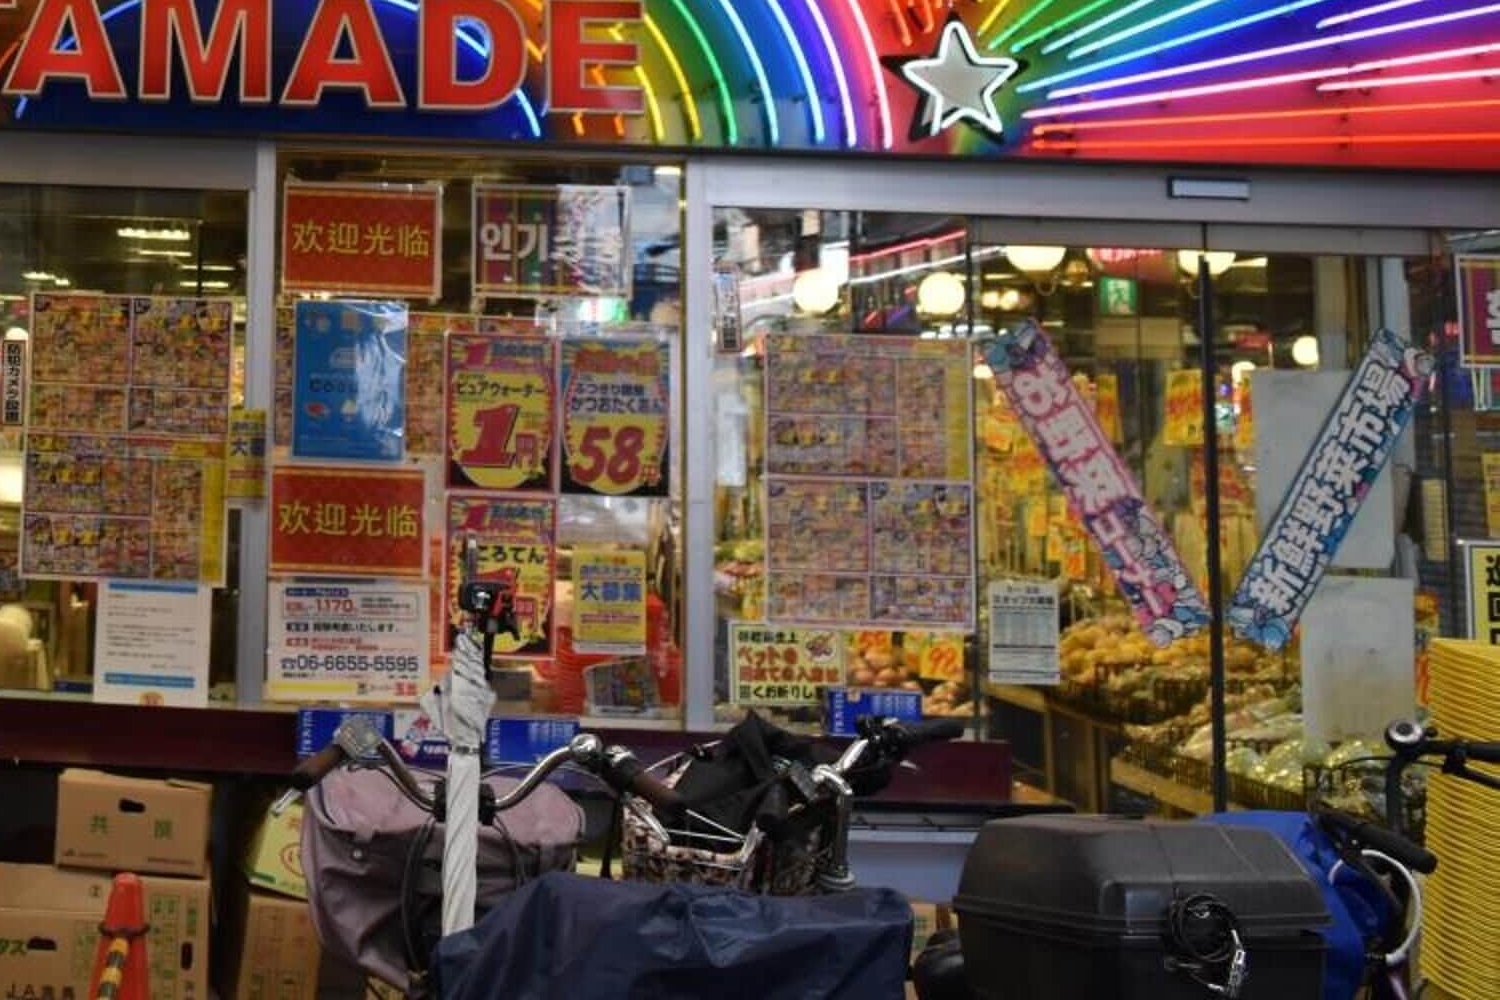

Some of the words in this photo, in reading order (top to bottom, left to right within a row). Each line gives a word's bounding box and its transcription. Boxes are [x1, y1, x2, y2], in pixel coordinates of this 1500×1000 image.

[291, 220, 430, 258] 欢迎光临
[278, 503, 420, 539] 欢迎光临
[297, 655, 420, 672] 06-6655-5595
